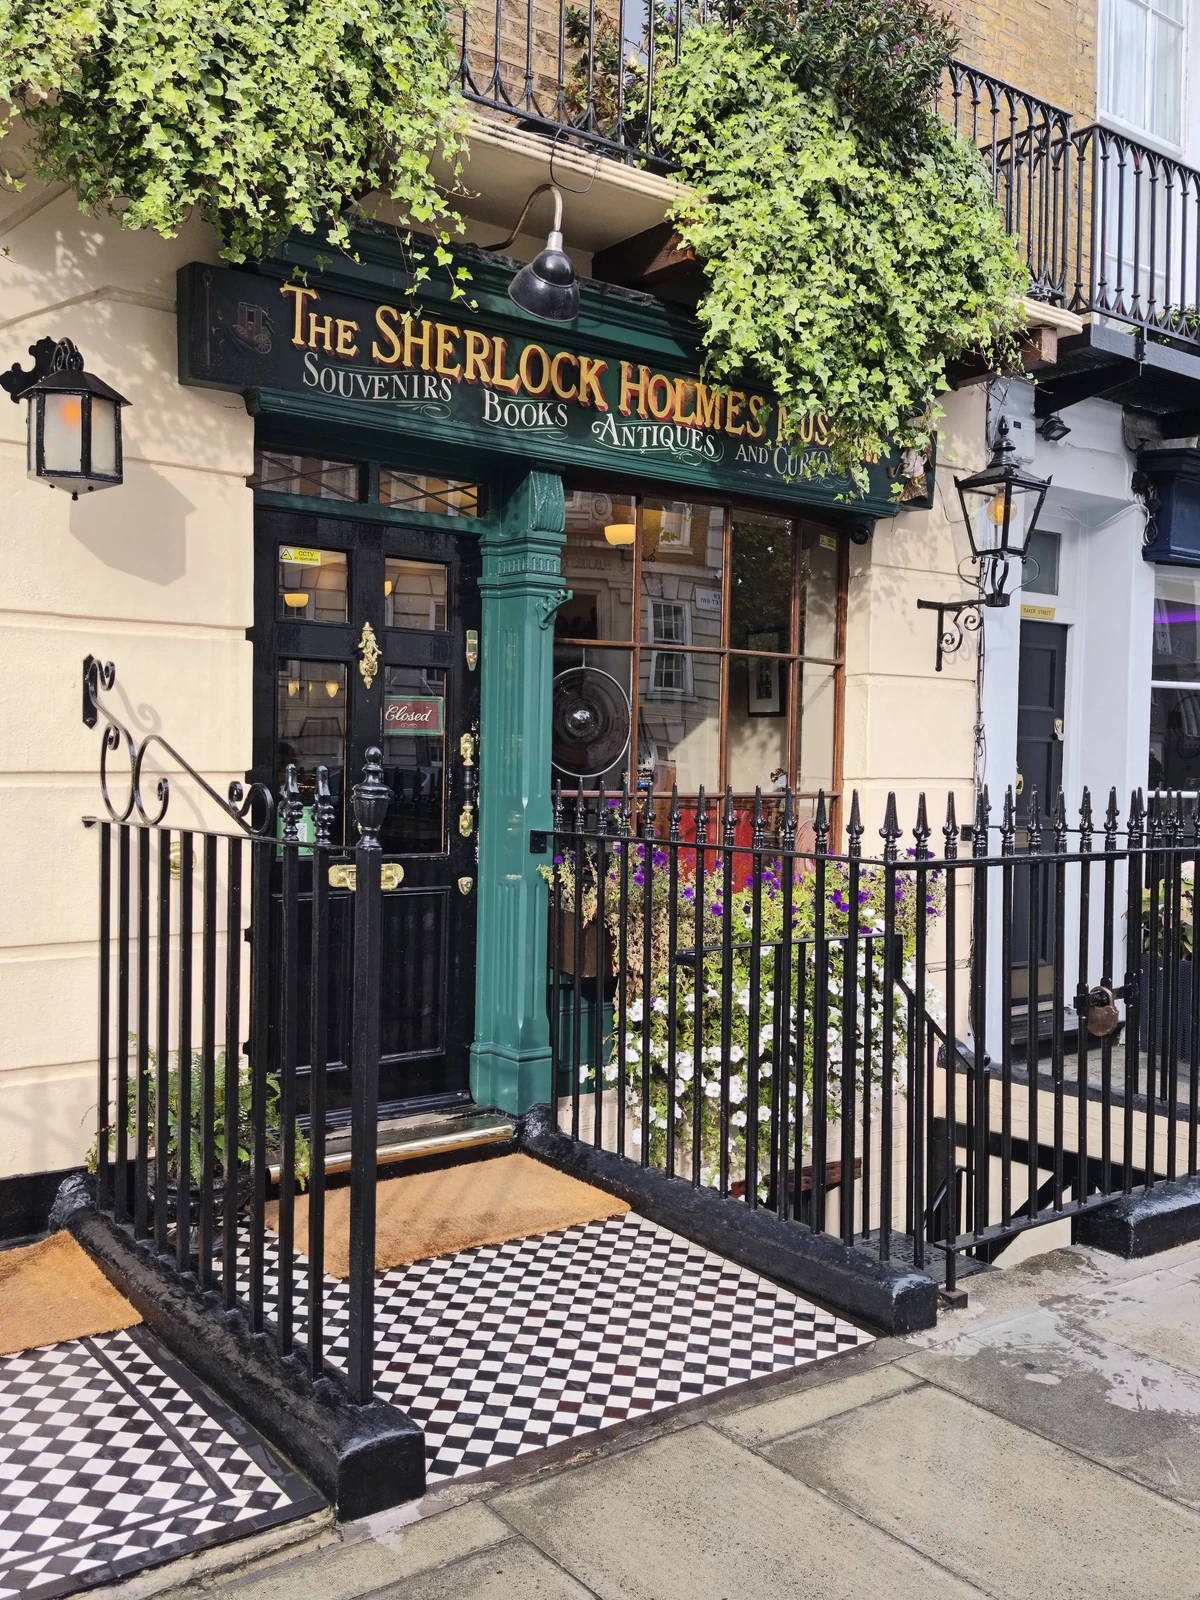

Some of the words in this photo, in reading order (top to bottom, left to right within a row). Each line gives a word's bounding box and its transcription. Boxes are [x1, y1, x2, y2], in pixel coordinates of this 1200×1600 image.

[280, 281, 360, 358] THE
[372, 305, 607, 411] SHERLOCK
[618, 360, 766, 440] HOLMES
[303, 351, 452, 402] SOUVENIRS
[483, 388, 568, 428] BOOKS
[592, 412, 715, 458] ANTIQUES
[735, 443, 768, 464] AND
[385, 704, 432, 722] Closed
